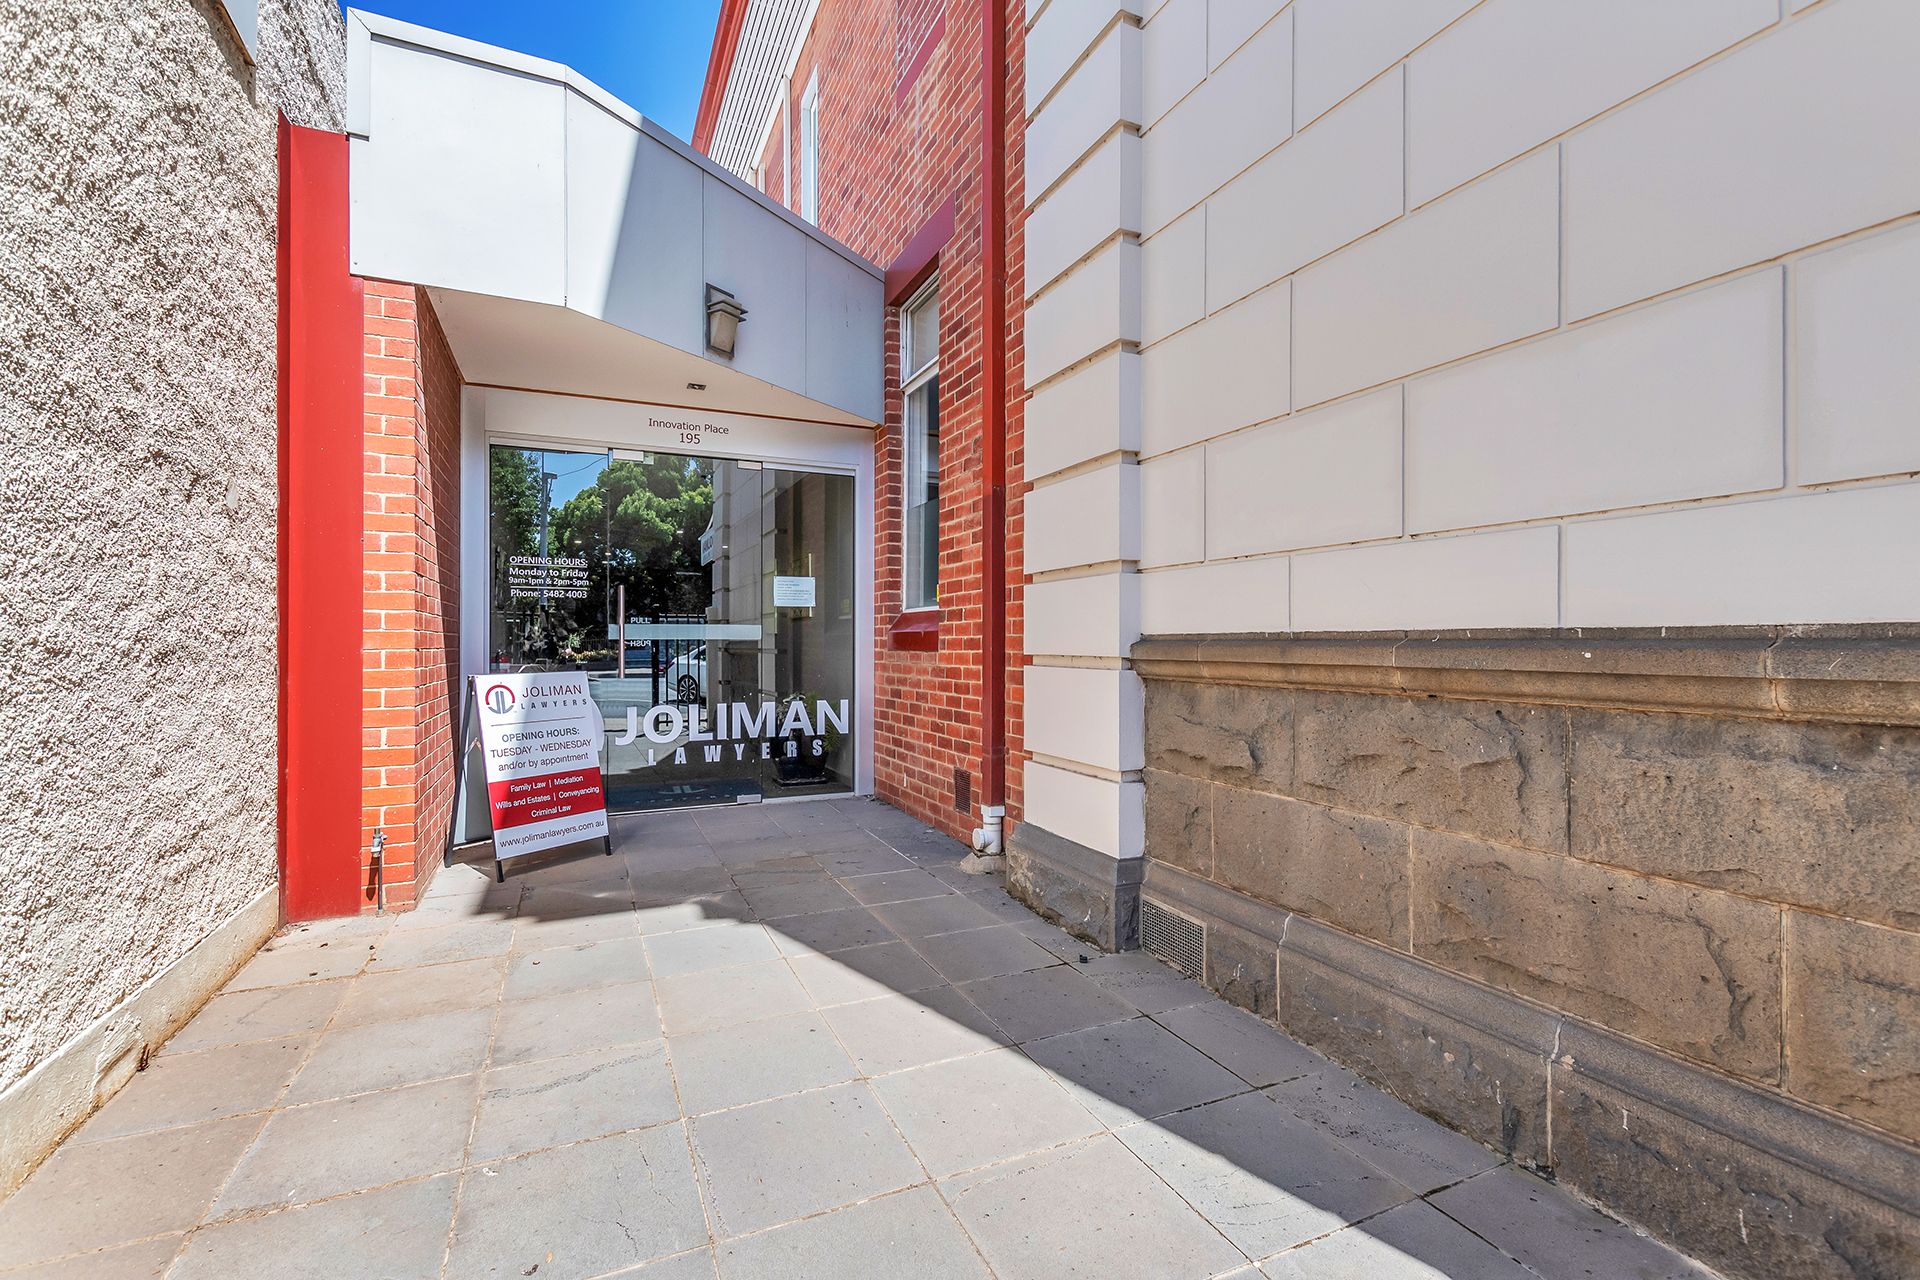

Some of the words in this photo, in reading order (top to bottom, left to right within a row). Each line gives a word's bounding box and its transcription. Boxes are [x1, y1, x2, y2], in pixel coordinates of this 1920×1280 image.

[648, 418, 700, 431] Innovation
[704, 424, 729, 434] Place
[680, 433, 700, 444] 195
[509, 556, 552, 565] OPENING
[554, 558, 588, 566] HOURS:
[509, 568, 547, 577] Monday
[561, 569, 588, 579] Friday
[508, 577, 544, 585] 9am-1pm
[553, 578, 589, 586] 2pm-5pm
[510, 589, 541, 597] Phone:
[543, 590, 564, 598] 5482
[630, 616, 651, 624] PULL
[522, 684, 582, 699] JOLIMAN
[521, 699, 587, 709] LAWYERS
[615, 699, 849, 746] JOLIMAN
[502, 731, 544, 743] OPENING
[546, 727, 579, 738] HOURS:
[491, 747, 532, 758] TUESDAY
[540, 739, 592, 752] WEDNESDAY
[648, 739, 823, 766] LAWYERS
[498, 760, 527, 772] and/or
[528, 758, 538, 768] by
[540, 753, 588, 767] appointment
[510, 781, 531, 792] Family
[532, 780, 546, 789] Law
[554, 775, 584, 785] Mediation
[495, 800, 512, 810] Wills
[514, 799, 526, 807] and
[527, 795, 551, 805] Estates
[558, 786, 600, 799] Conveyancing
[531, 807, 557, 817] Criminal
[558, 804, 572, 813] Law
[500, 820, 604, 847] www.jolimanlawyers.comau
